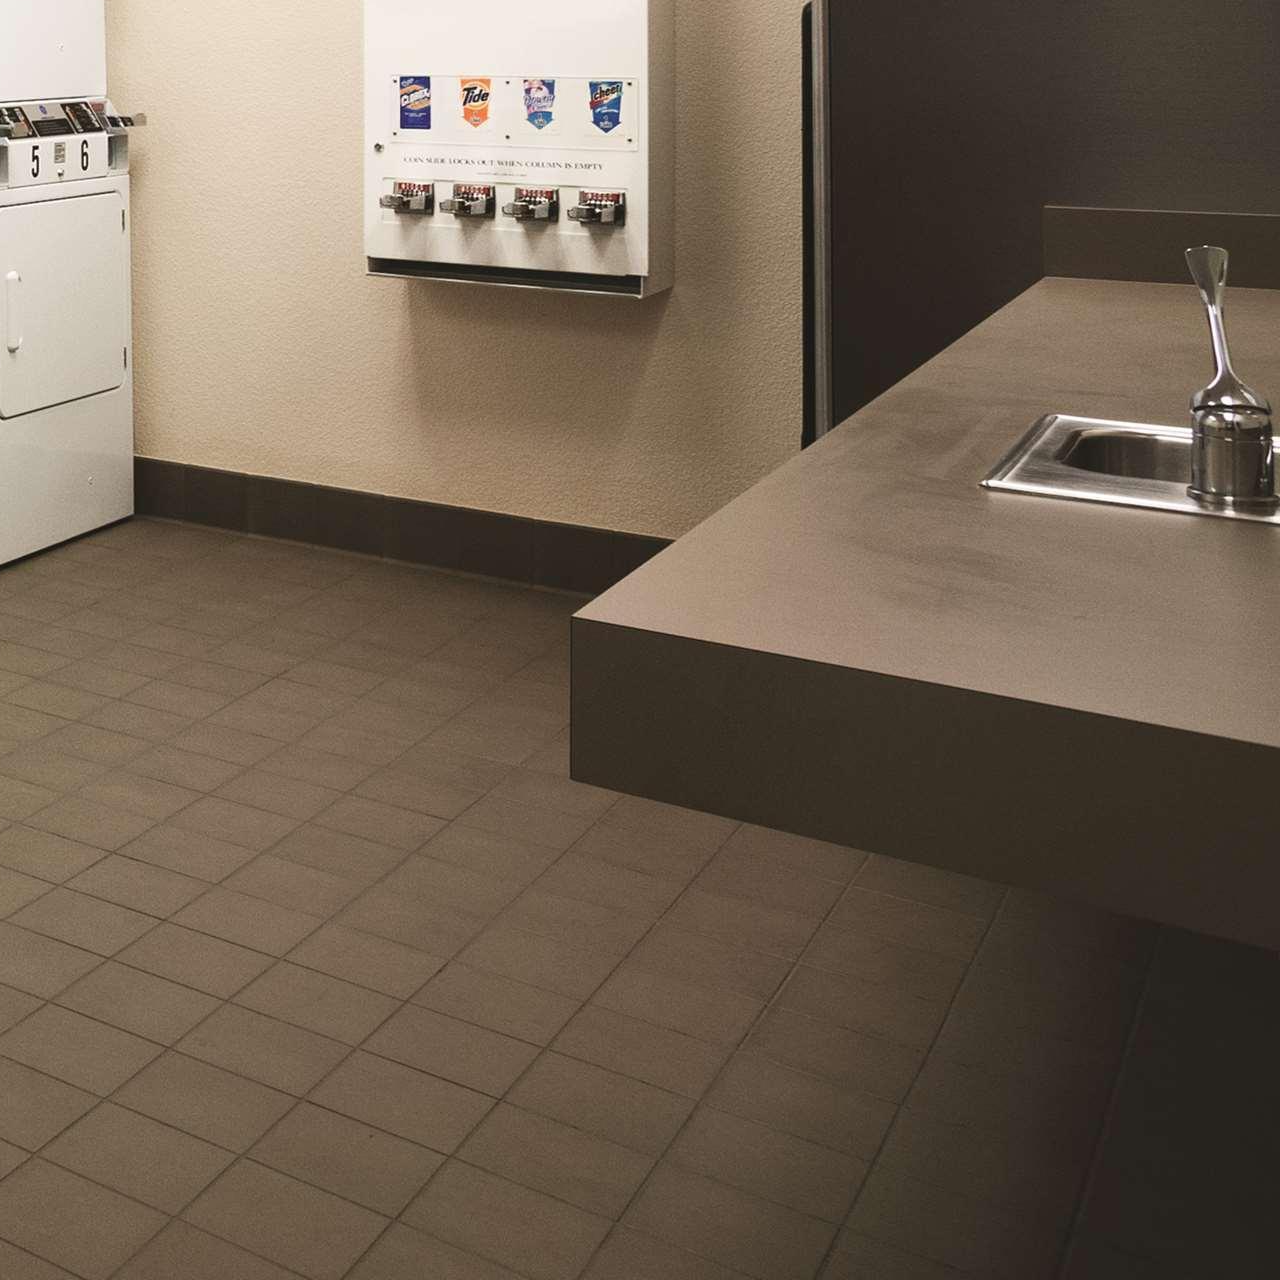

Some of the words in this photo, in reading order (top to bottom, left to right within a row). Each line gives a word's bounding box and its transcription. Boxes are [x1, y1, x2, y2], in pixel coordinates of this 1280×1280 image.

[462, 86, 489, 108] Tide
[31, 145, 40, 179] 5
[80, 139, 89, 172] 6
[525, 161, 562, 169] COLUMN
[574, 162, 603, 170] EMPTY
